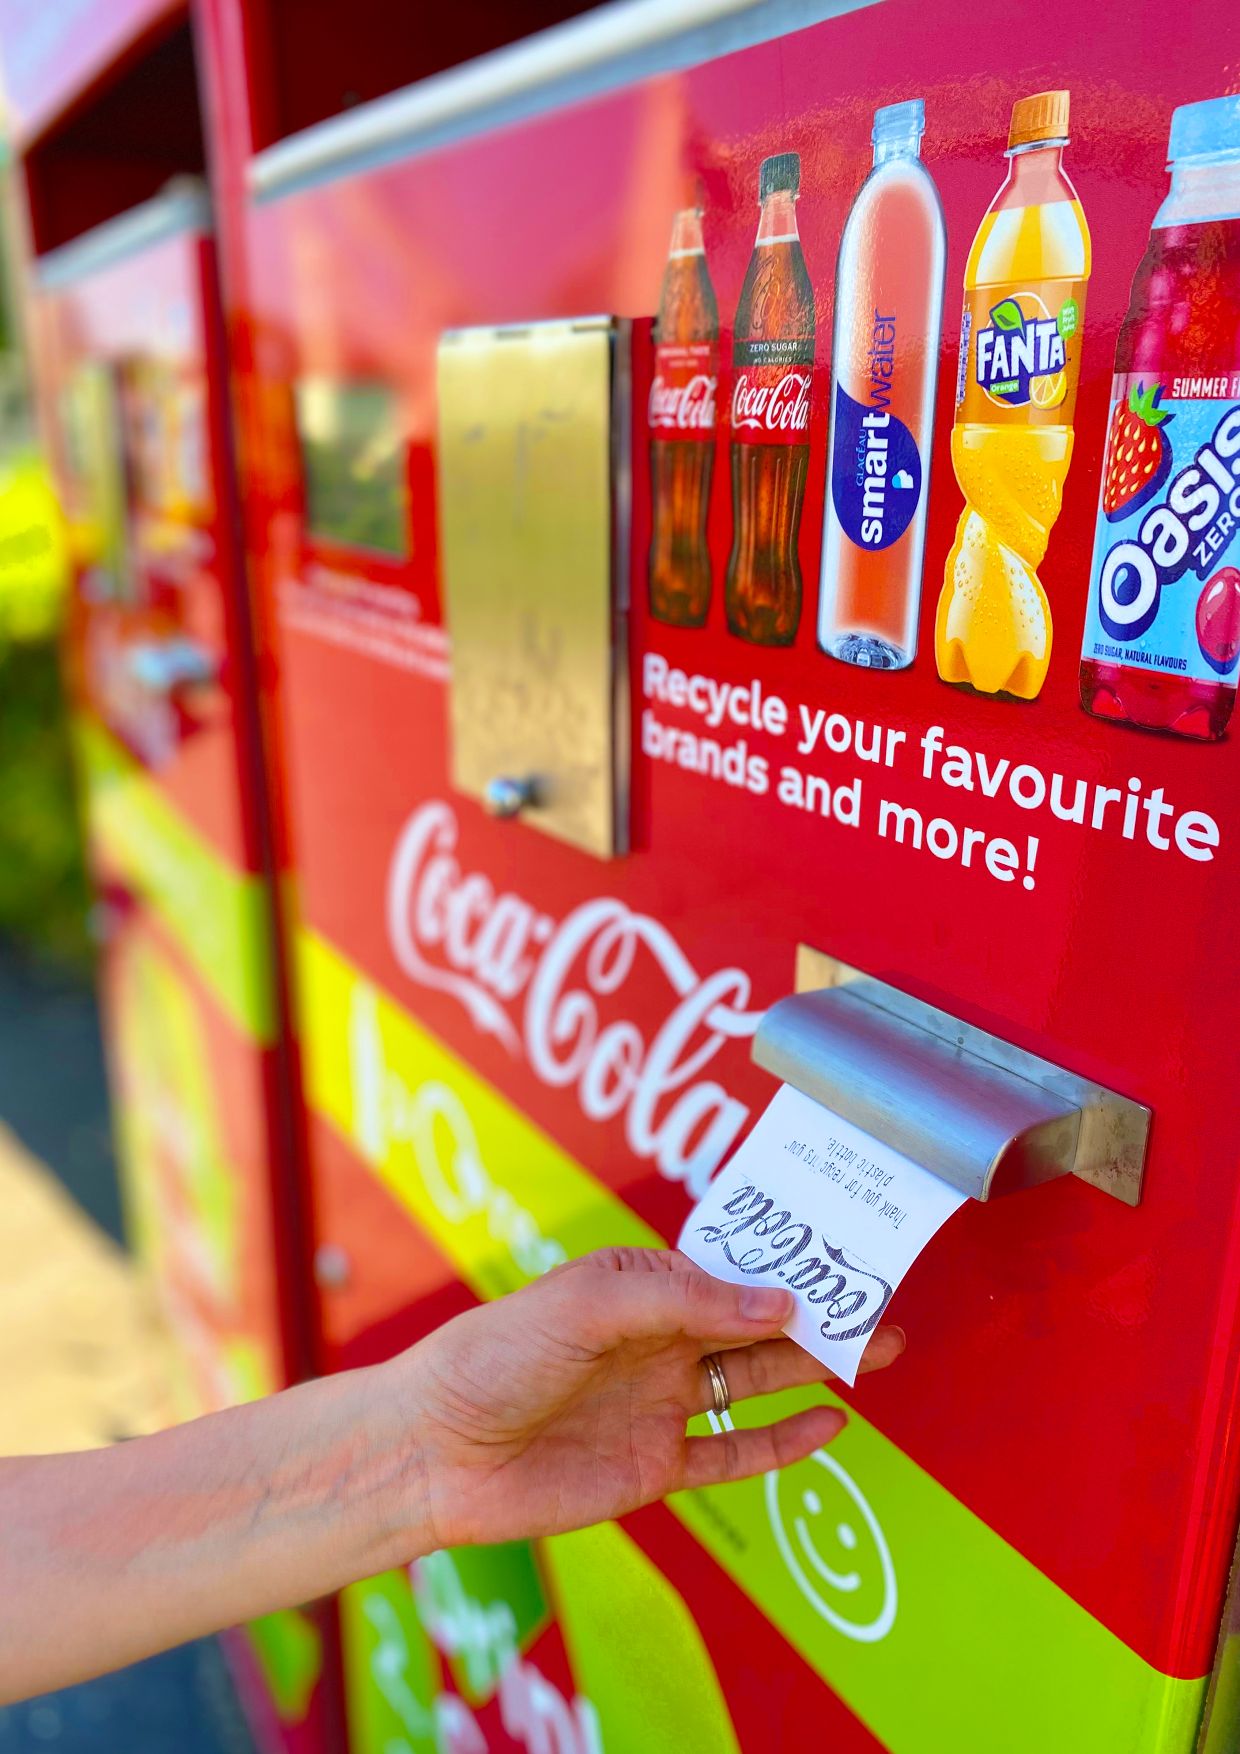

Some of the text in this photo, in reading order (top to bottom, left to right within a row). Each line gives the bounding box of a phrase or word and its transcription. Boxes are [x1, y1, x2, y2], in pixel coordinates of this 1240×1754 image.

[750, 342, 798, 353] ZERO SUGAR
[977, 322, 1065, 382] FANTA
[731, 373, 812, 431] Coca-Cola
[990, 381, 1018, 393] Orange
[1172, 377, 1240, 398] SUMMER F
[855, 429, 868, 487] GLACÉAU
[1104, 645, 1123, 661] SUGAR,
[1124, 649, 1152, 664] NATURAL
[1153, 654, 1187, 671] FLAVOURS
[643, 653, 1221, 862] Recycle your favourite
[643, 710, 1040, 891] brands and more!
[386, 799, 768, 1201] Coca-Cola
[826, 1137, 895, 1188] plastic bottle.
[844, 1178, 863, 1199] for
[861, 1188, 882, 1208] you
[878, 1200, 907, 1229] Thank
[695, 1185, 893, 1342] Coca-Cola
